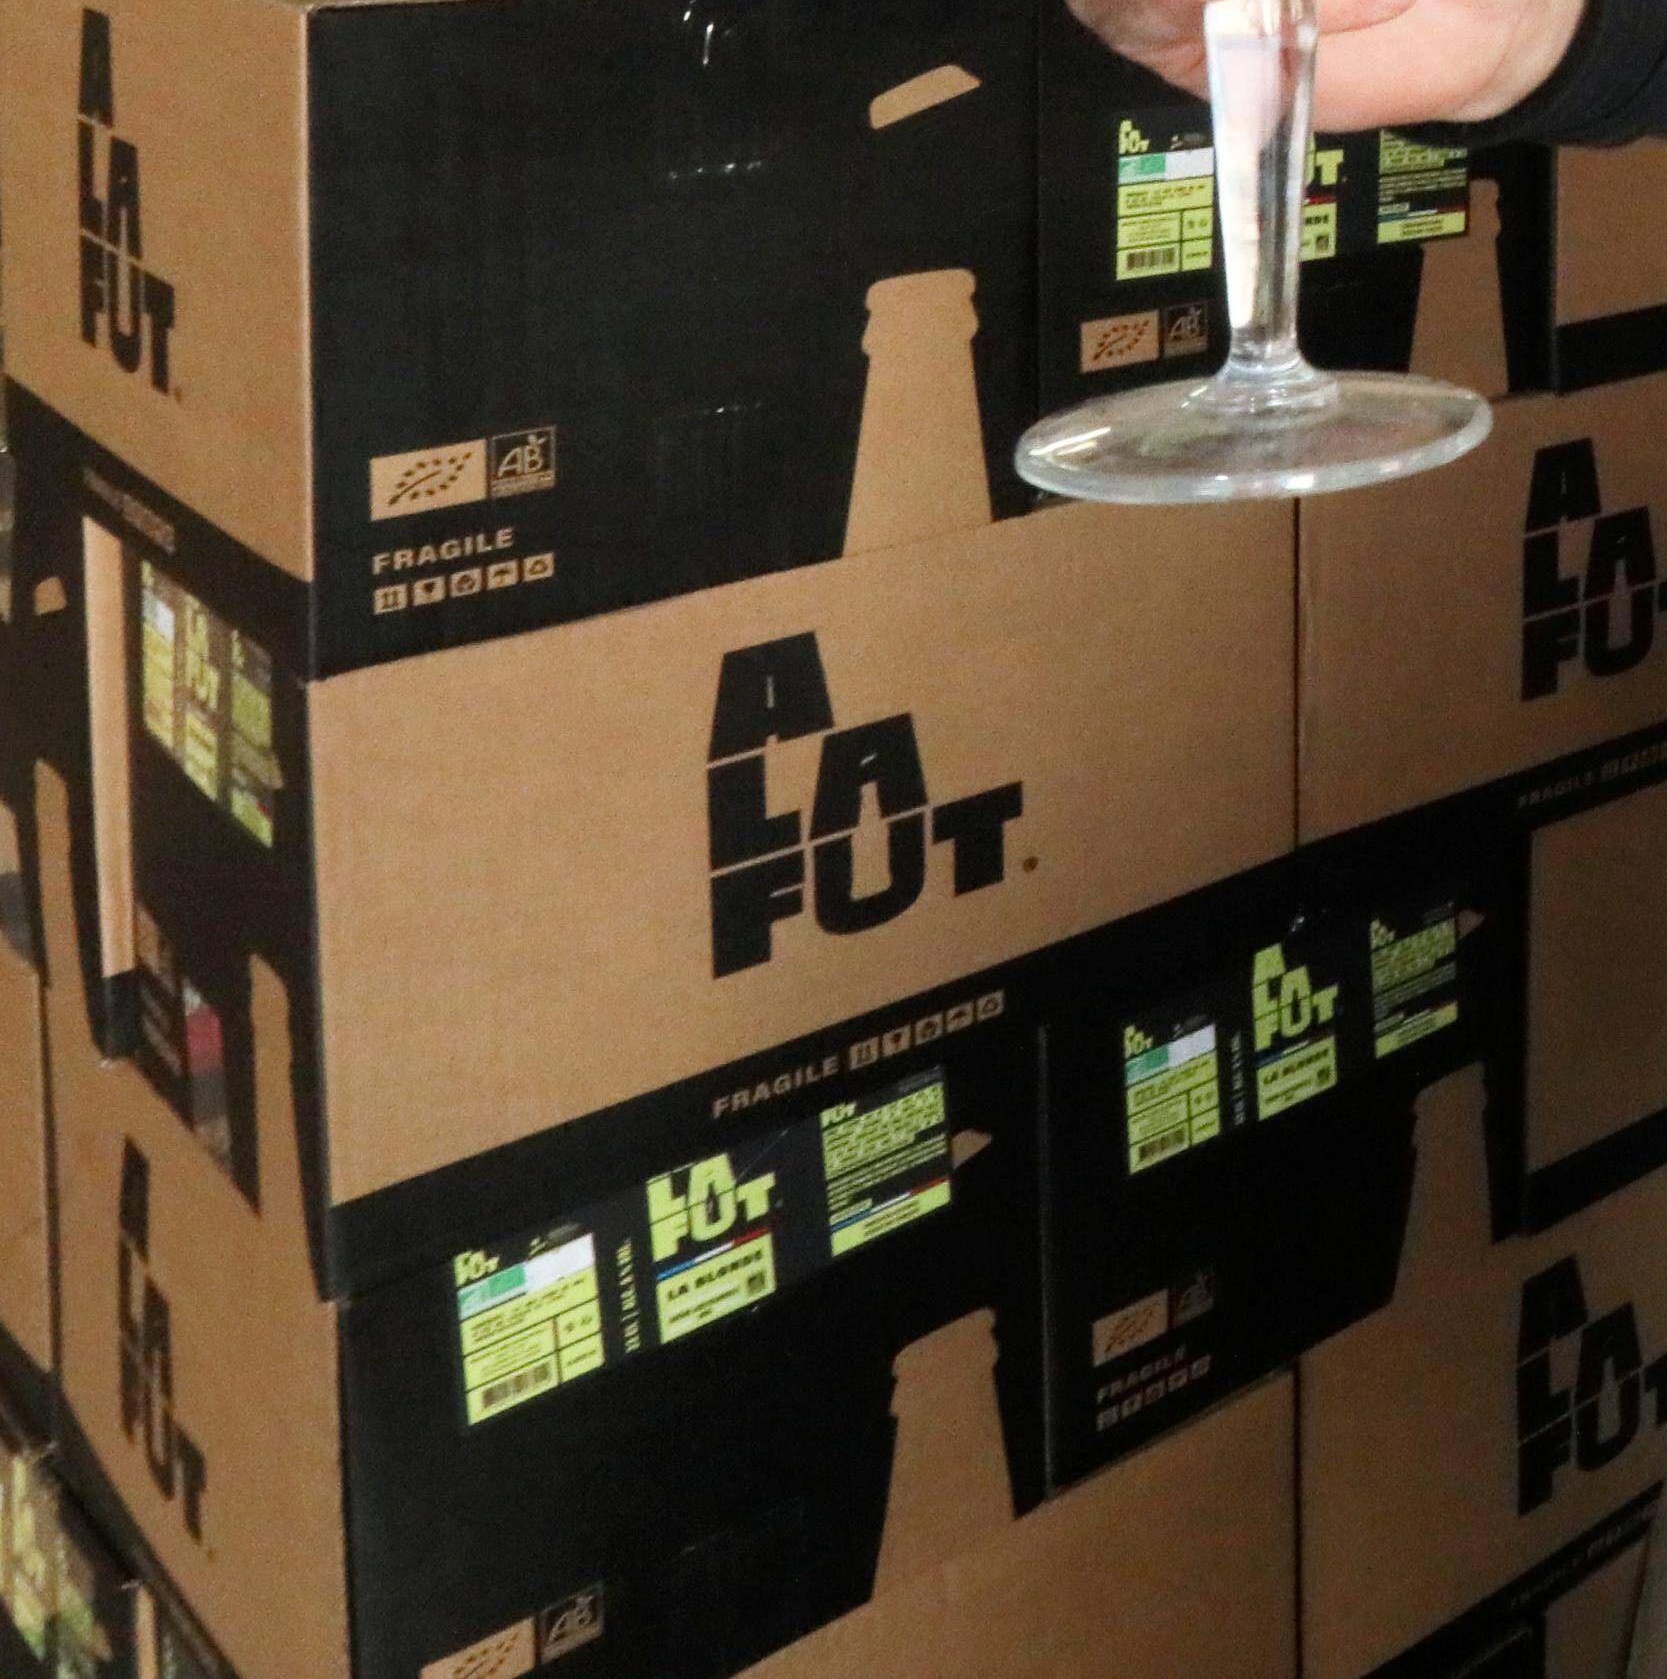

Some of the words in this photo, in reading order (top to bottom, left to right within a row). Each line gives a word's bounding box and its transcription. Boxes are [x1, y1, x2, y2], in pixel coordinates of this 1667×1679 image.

[372, 527, 514, 576] FRAGILE
[1523, 506, 1657, 619] LA
[707, 631, 834, 763] A
[707, 712, 928, 872] LA
[712, 1054, 841, 1119] FRAGILE
